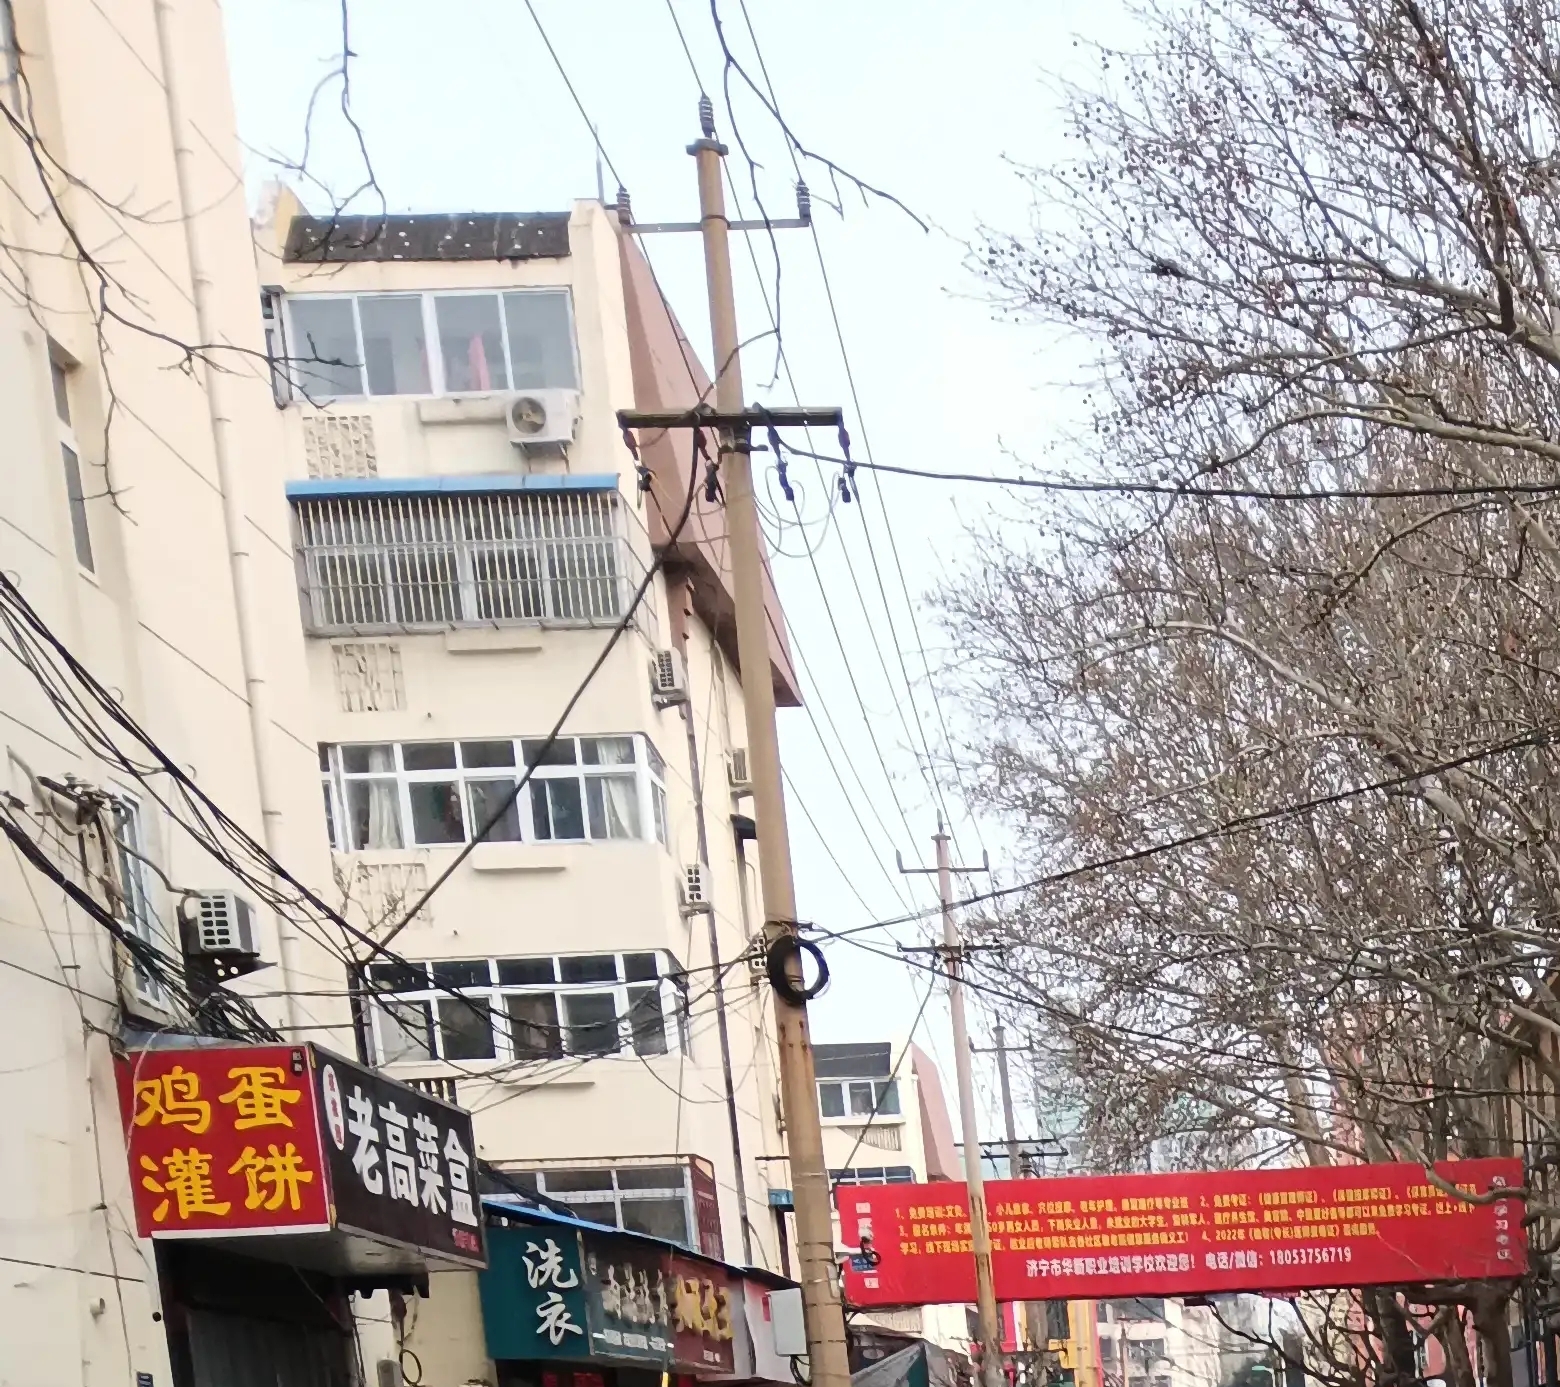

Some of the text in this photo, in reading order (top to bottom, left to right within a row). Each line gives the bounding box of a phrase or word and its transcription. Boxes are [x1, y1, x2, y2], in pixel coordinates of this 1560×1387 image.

[133, 1065, 301, 1134] 鸡蛋
[140, 1142, 313, 1222] 灌饼
[347, 1085, 478, 1227] 老高菜盒
[522, 1238, 583, 1346] 洗衣
[1269, 1246, 1352, 1266] 18053756719
